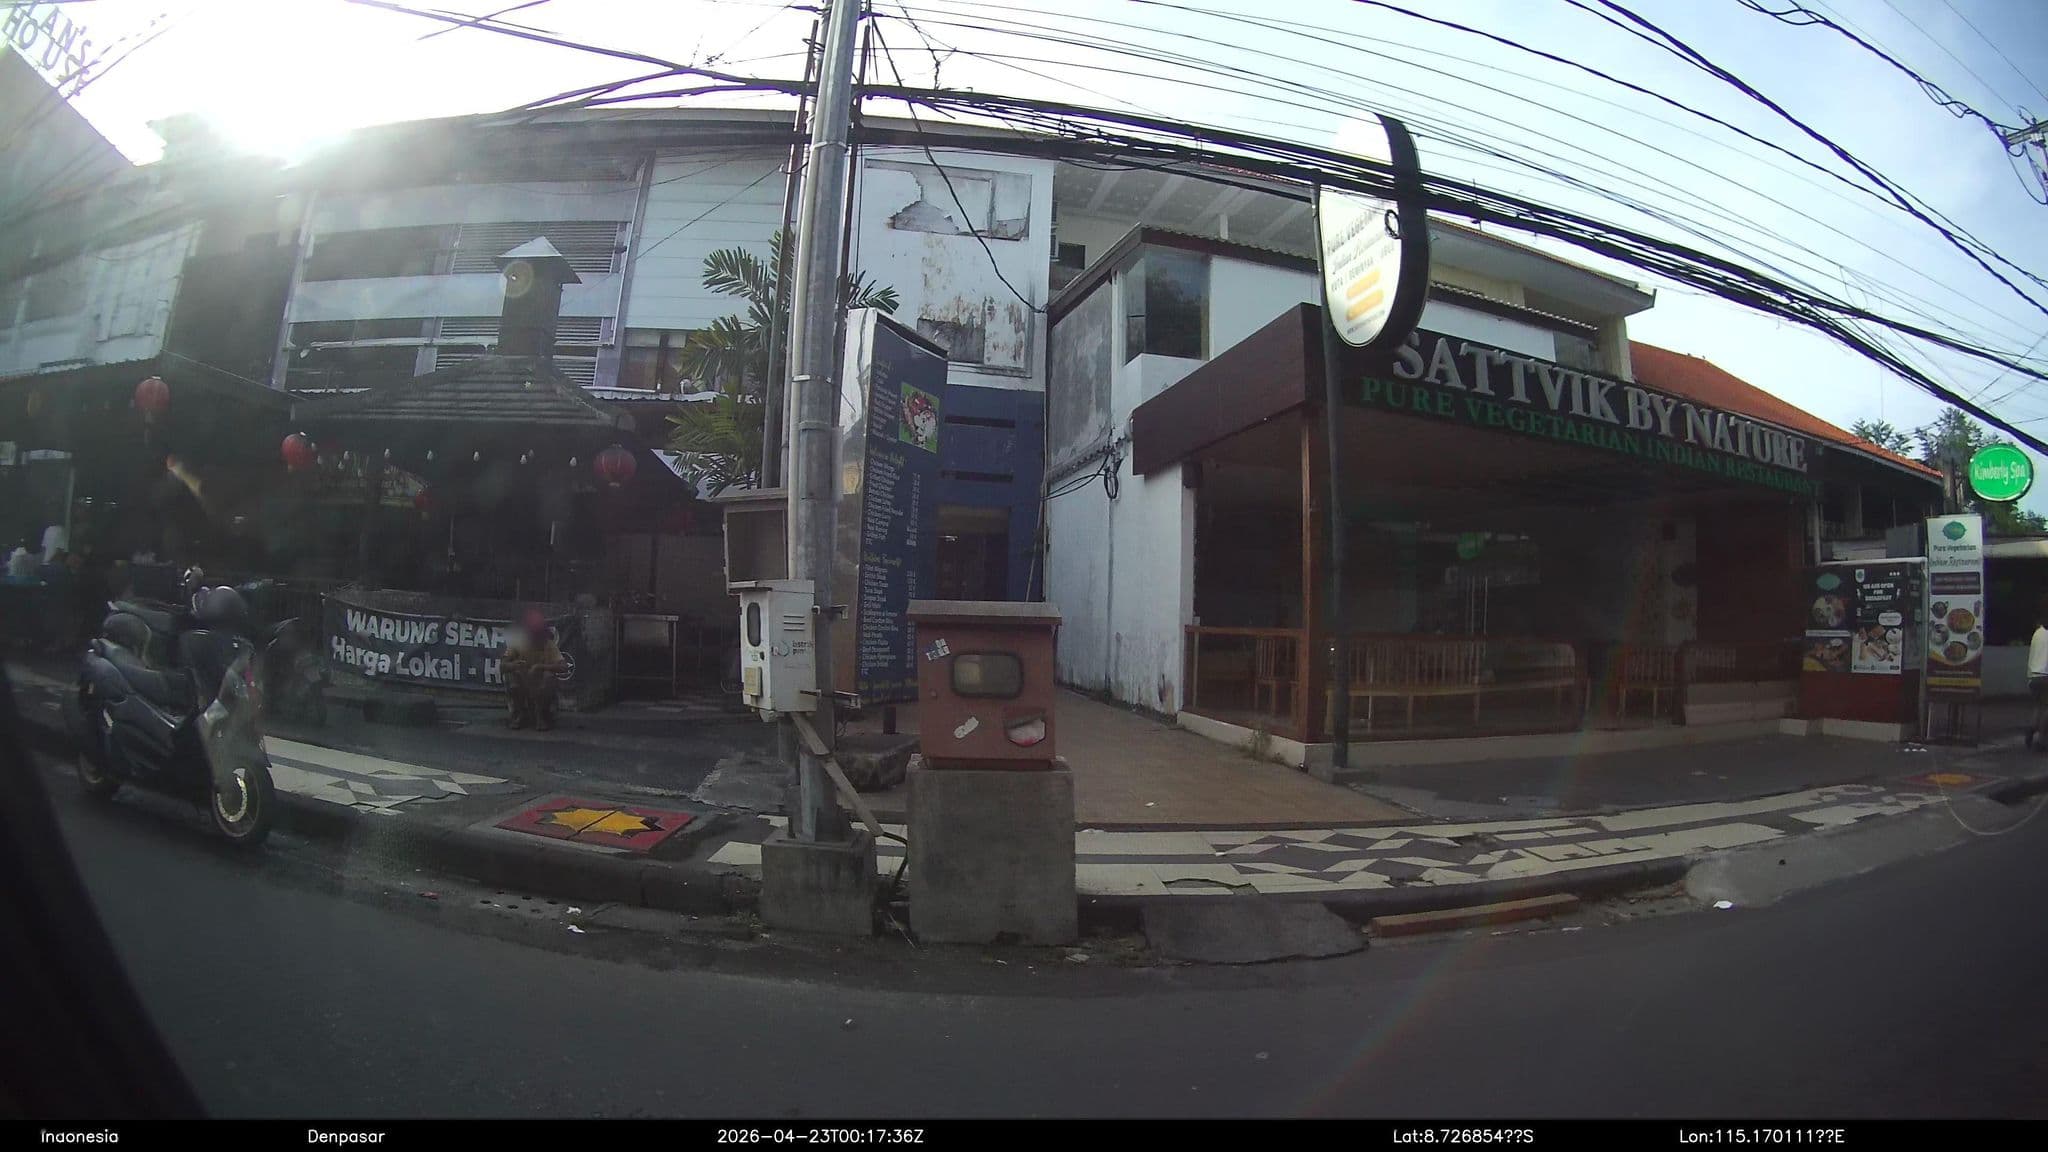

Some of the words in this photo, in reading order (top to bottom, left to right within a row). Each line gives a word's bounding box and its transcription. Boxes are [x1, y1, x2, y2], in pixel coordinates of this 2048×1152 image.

[1393, 331, 1619, 424] SATTVIK
[1624, 386, 1678, 438] BY
[1681, 403, 1808, 472] NATURE
[1362, 375, 1456, 417] PURE
[1465, 397, 1641, 455] VEGETARIAN
[1647, 436, 1719, 476] INDIAN
[1974, 459, 2009, 485] Kimberly
[2010, 461, 2026, 485] Spa
[346, 608, 439, 644] WARUNG
[331, 636, 391, 676] Harga
[396, 652, 461, 681] Lokal
